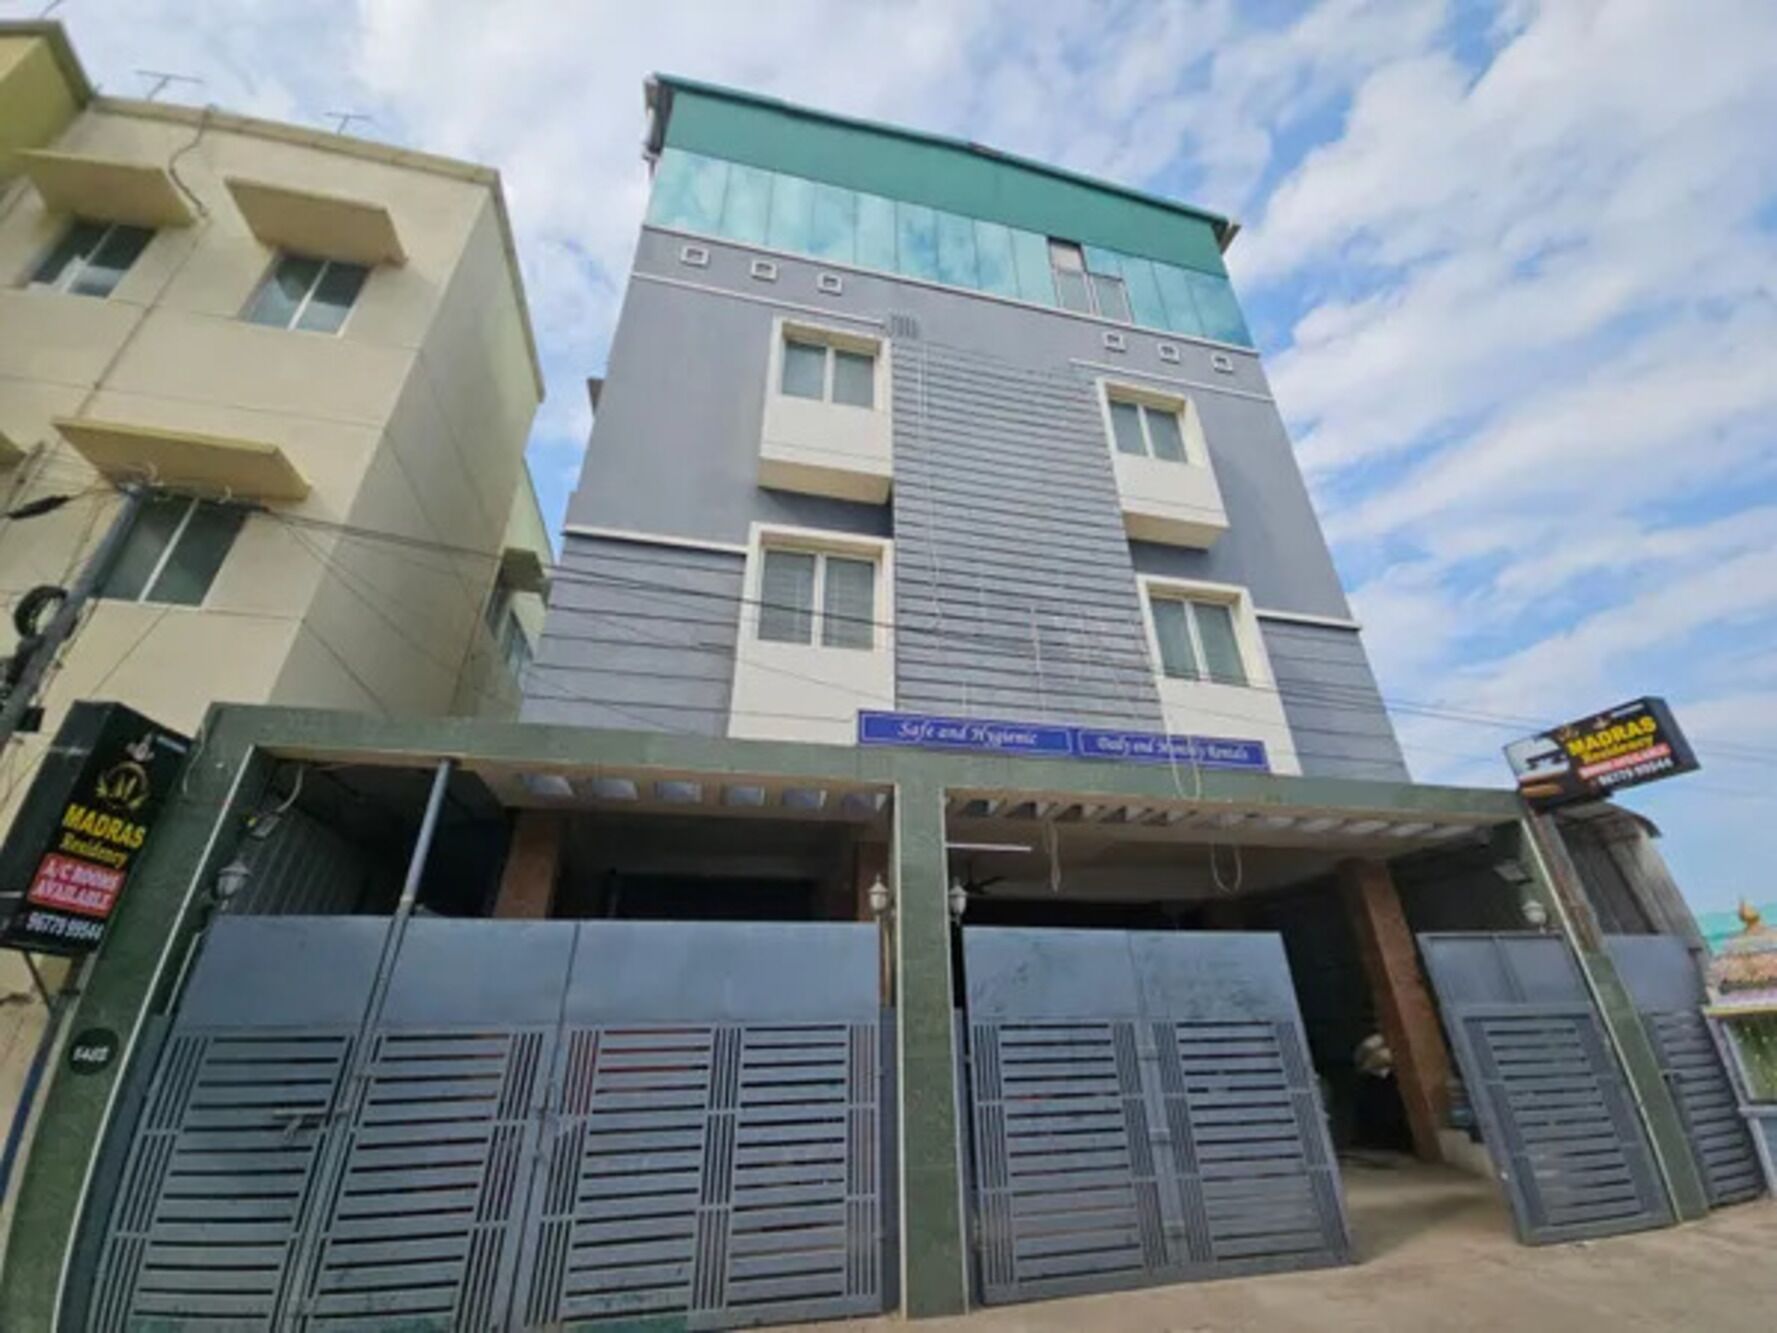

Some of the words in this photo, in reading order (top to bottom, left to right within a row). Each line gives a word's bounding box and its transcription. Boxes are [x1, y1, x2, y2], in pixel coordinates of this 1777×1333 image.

[897, 721, 934, 743] Safe
[938, 723, 967, 741] and
[971, 724, 1038, 748] Hygienic
[1134, 737, 1155, 753] and
[1567, 715, 1657, 756] MADRAS
[62, 803, 146, 848] MADRAS
[60, 832, 128, 869] Residency
[32, 879, 112, 909] AVAILABLE
